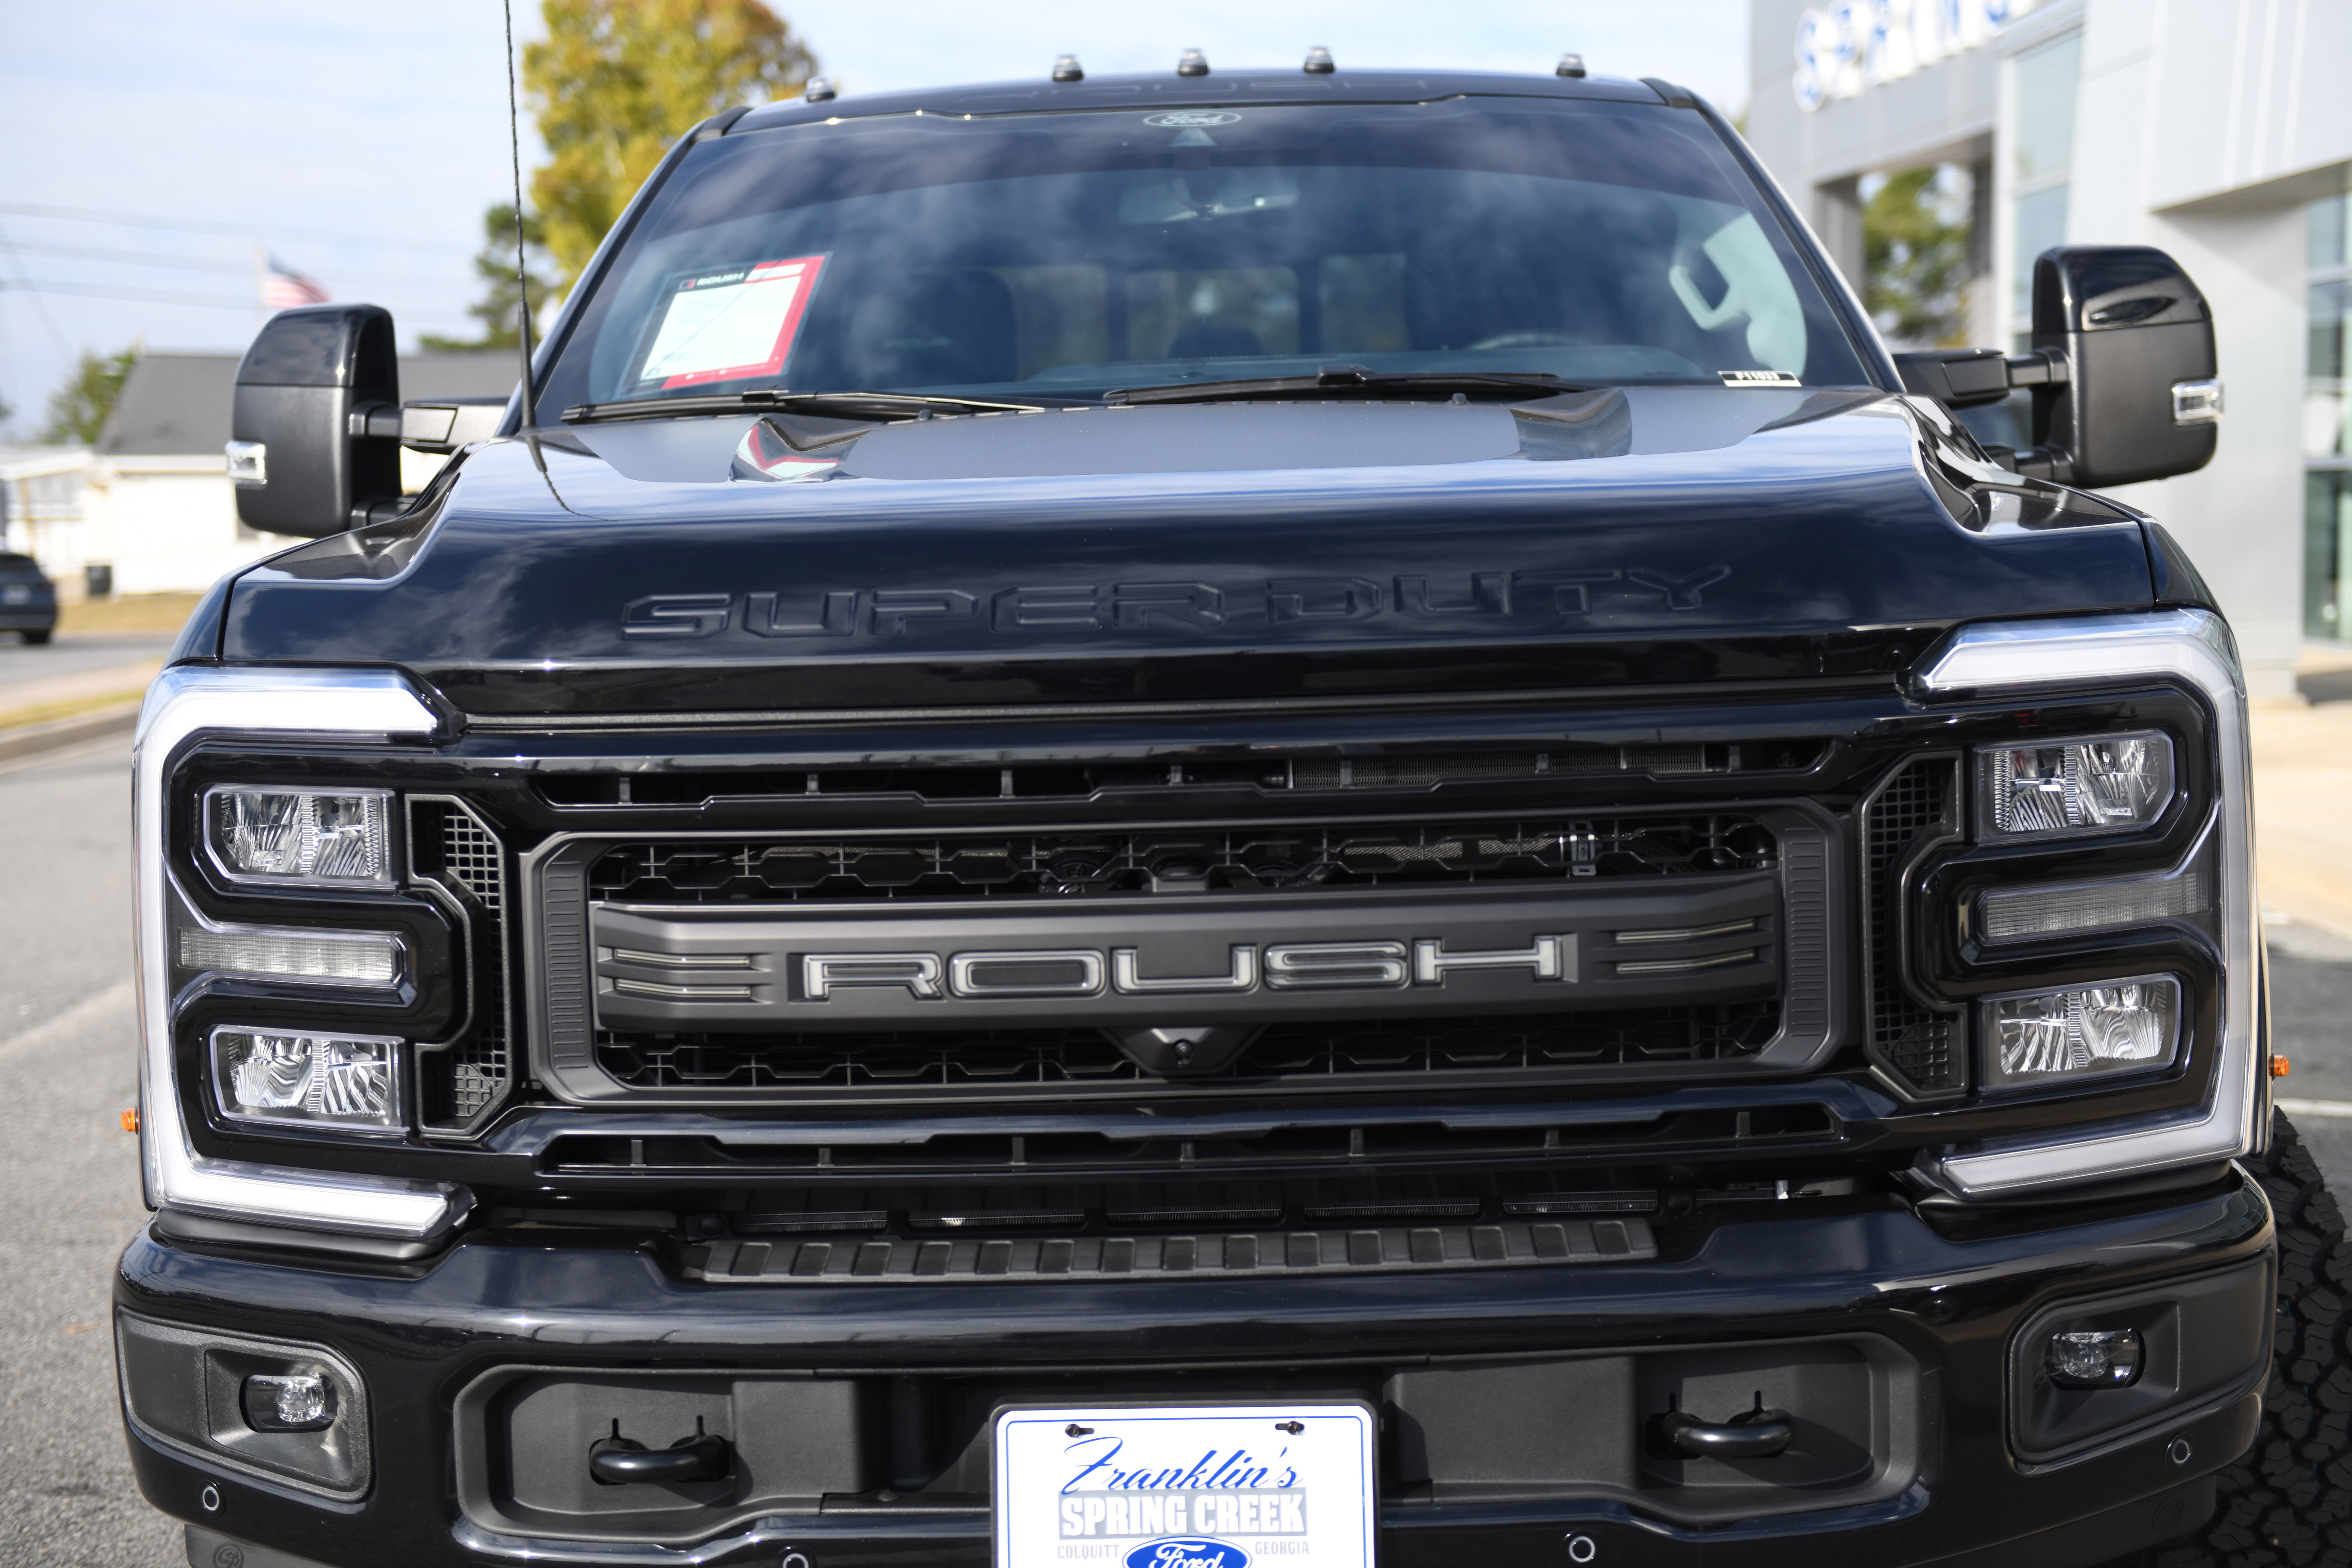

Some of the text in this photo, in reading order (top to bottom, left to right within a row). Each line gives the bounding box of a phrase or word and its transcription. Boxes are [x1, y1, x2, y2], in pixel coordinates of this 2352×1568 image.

[1159, 113, 1225, 125] Ford
[618, 564, 1731, 639] SUPER DUTY
[802, 933, 1563, 1002] ROUSH
[1061, 1437, 1304, 1495] Franklin's
[1062, 1494, 1305, 1536] SPRING CREEK
[1057, 1545, 1120, 1560] COLQUITT
[1255, 1541, 1309, 1555] GEORGIA
